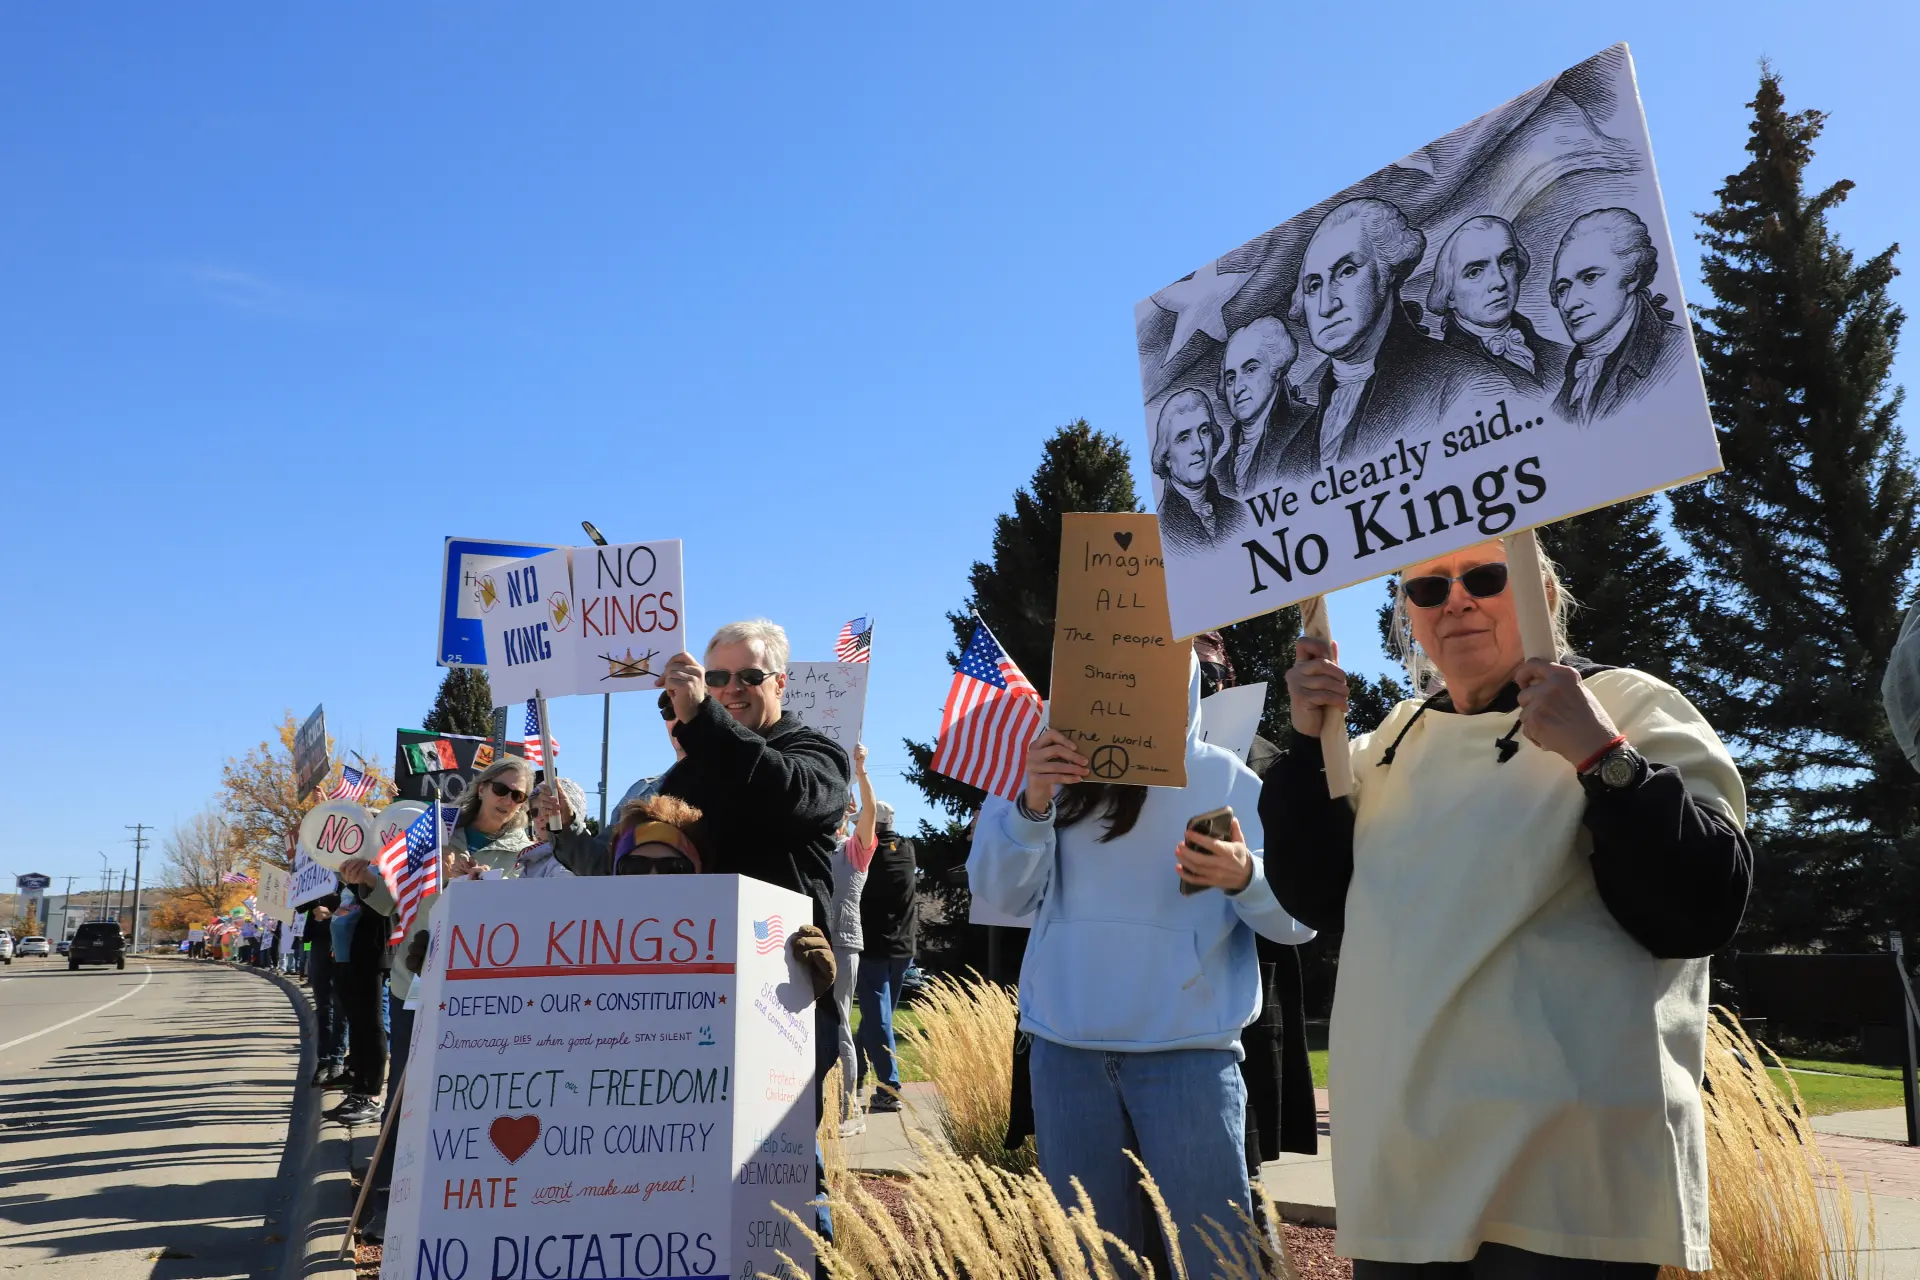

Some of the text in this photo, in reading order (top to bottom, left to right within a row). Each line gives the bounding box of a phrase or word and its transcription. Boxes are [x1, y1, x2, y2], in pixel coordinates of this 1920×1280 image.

[1246, 400, 1544, 527] We clearly said...
[1242, 456, 1547, 594] No Kings
[597, 545, 657, 589] NO
[1085, 541, 1165, 577] Imagine
[507, 565, 539, 608] NO
[1097, 588, 1145, 611] ALL
[582, 591, 678, 638] KINGS
[504, 622, 552, 667] KING
[1064, 628, 1165, 648] The people
[447, 654, 463, 664] 25
[785, 666, 830, 684] e Are
[1085, 665, 1136, 688] Sharing
[781, 683, 847, 709] ghting for
[1090, 700, 1131, 716] ALL
[1060, 729, 1157, 749] The world.
[420, 773, 467, 800] NO
[317, 814, 364, 855] NO
[449, 918, 716, 969] NO KINGS!
[449, 991, 716, 1017] DEFEND OUR CONSTITUTION
[438, 1030, 693, 1054] Democracy DIES when good people STAY SILENT
[754, 999, 803, 1056] and compassion
[435, 1069, 565, 1112] PROTECT
[565, 1081, 580, 1094] our
[588, 1066, 729, 1108] FREEDOM!
[433, 1127, 480, 1161] WE
[544, 1125, 594, 1156] OUR
[604, 1122, 715, 1154] COUNTRY
[753, 1127, 804, 1157] Help Save
[740, 1163, 809, 1185] DEMOCRACY
[443, 1177, 518, 1210] HATE
[576, 1179, 620, 1198] make
[620, 1182, 640, 1196] us
[746, 1221, 793, 1248] SPEAK
[416, 1238, 468, 1280] NO
[491, 1232, 717, 1280] DICTATORS
